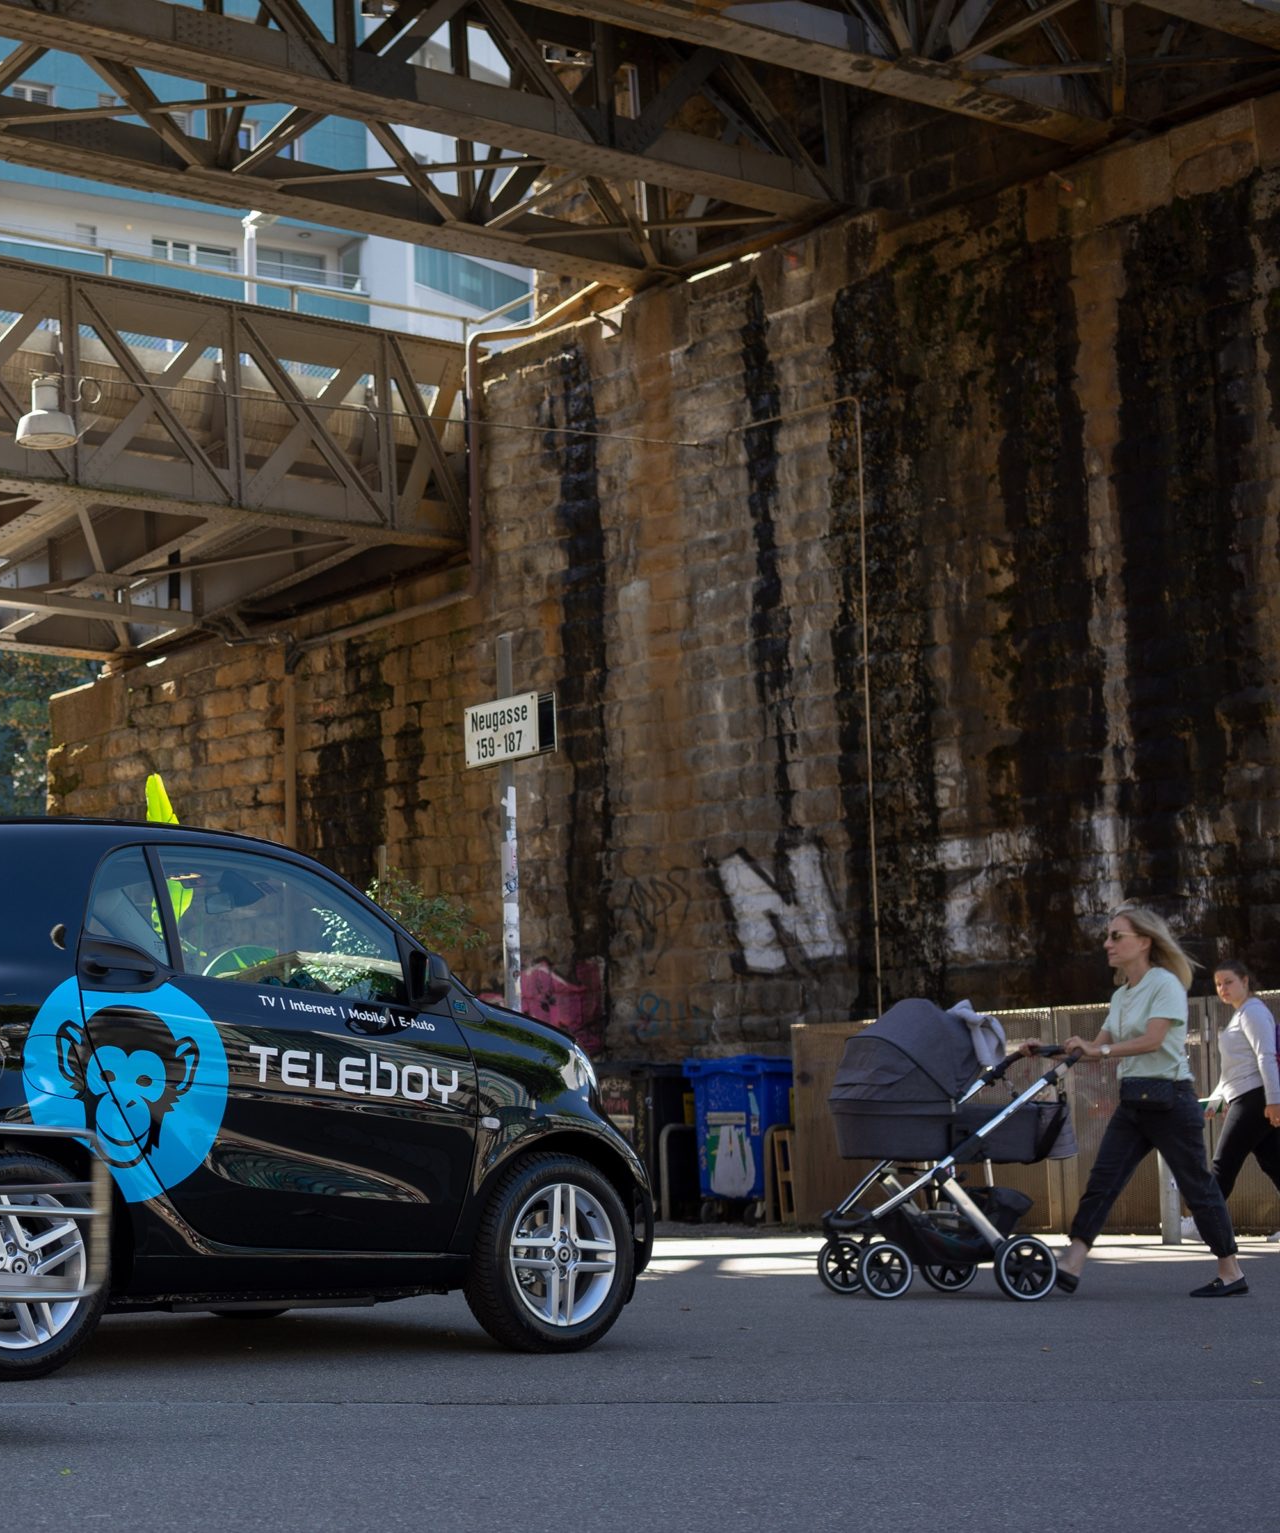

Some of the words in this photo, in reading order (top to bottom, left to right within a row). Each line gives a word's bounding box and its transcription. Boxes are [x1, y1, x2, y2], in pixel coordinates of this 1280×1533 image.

[471, 704, 528, 733] Neugasse
[258, 995, 275, 1007] TV
[289, 999, 336, 1017] Internet
[349, 1008, 386, 1024] Mobile
[399, 1016, 436, 1032] E-Auto
